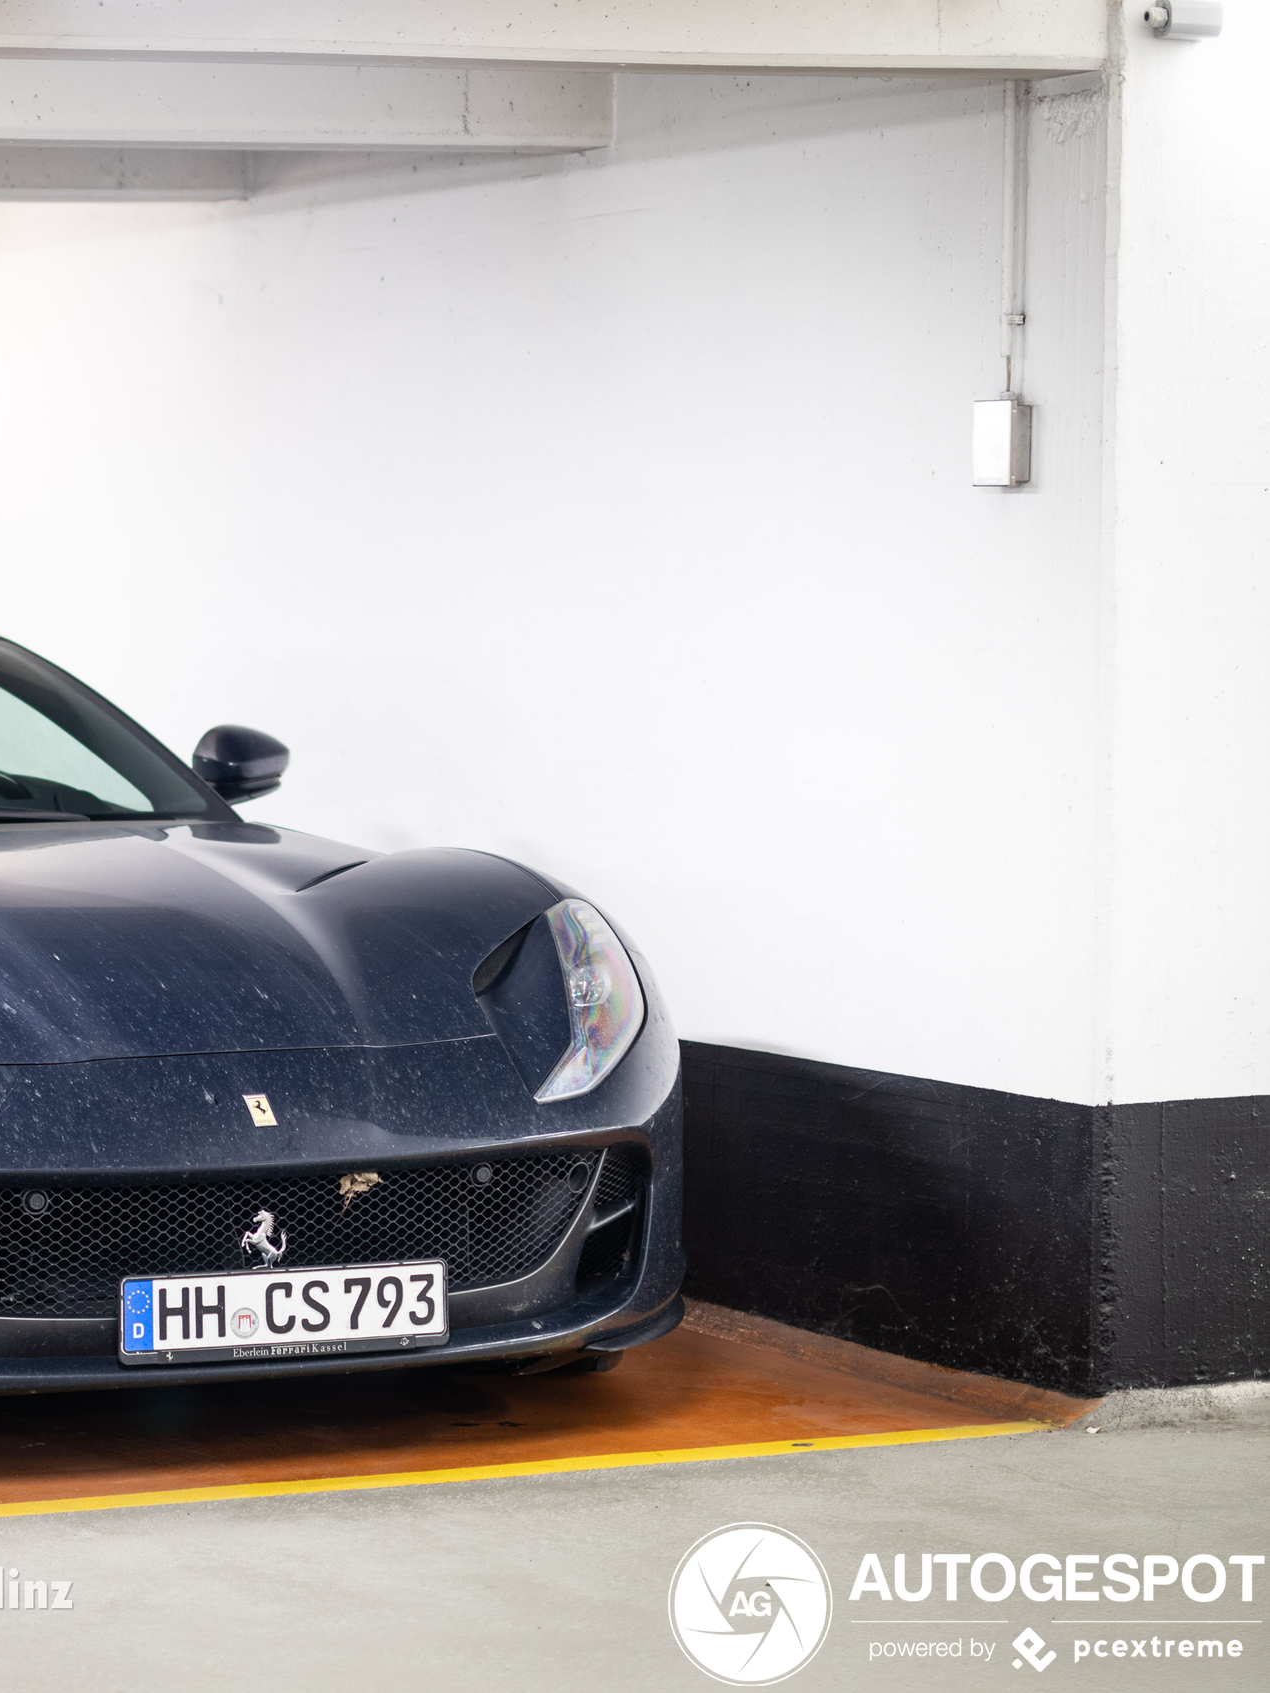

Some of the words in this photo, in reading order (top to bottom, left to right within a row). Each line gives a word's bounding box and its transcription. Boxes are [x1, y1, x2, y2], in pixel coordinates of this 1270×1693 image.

[158, 1285, 226, 1341] HH
[265, 1280, 331, 1334] CS
[343, 1273, 436, 1330] 793
[132, 1322, 145, 1339] D
[232, 1347, 269, 1358] Eberlein
[270, 1344, 310, 1356] Ferrari
[311, 1341, 347, 1353] Kassel
